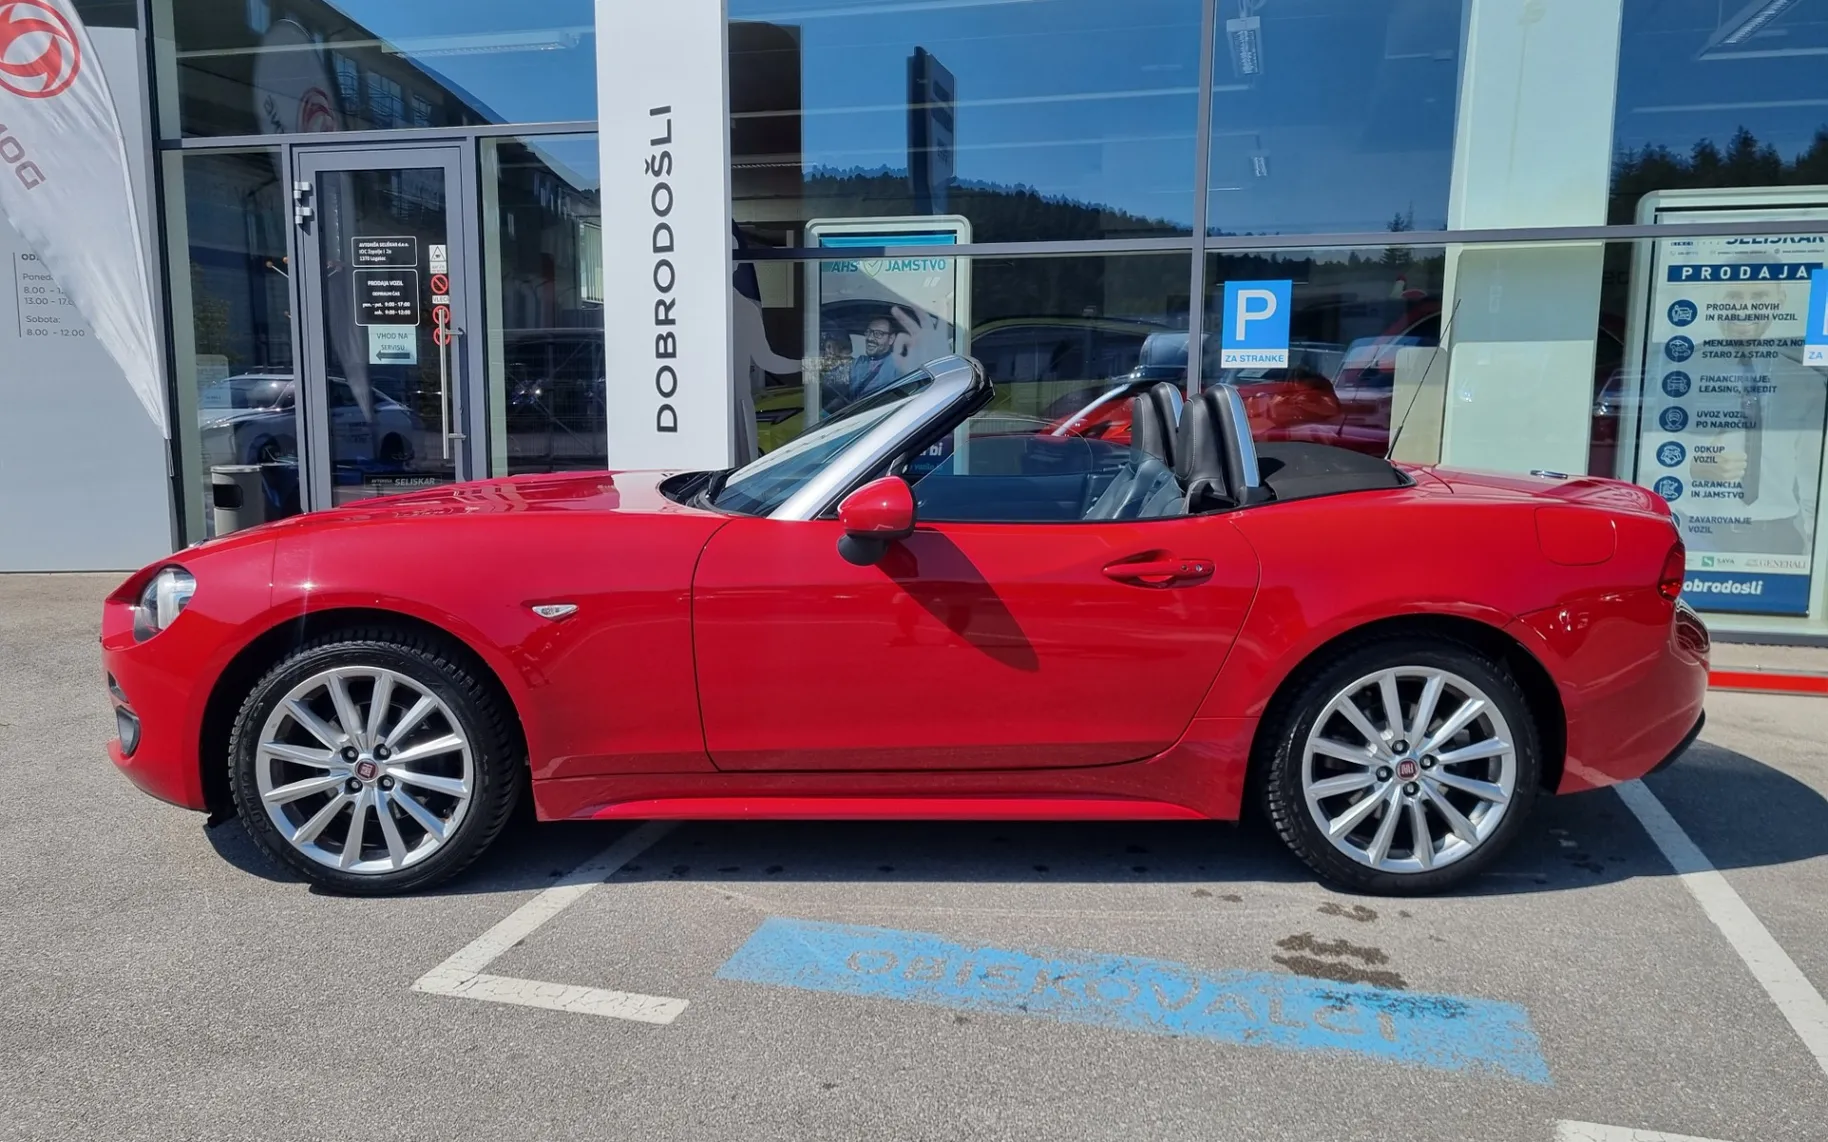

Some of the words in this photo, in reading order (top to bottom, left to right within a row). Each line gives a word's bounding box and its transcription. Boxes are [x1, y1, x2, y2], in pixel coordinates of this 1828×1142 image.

[644, 105, 678, 433] DOBRODOŠLI
[885, 259, 947, 272] JAMSTVO
[1681, 265, 1809, 280] PRODAJA
[24, 286, 46, 294] 8.00
[1706, 303, 1749, 311] PRODAJA
[1751, 302, 1780, 310] NOVIH
[26, 315, 61, 323] Sobota:
[1236, 289, 1277, 341] P
[1705, 313, 1715, 321] IN
[1717, 313, 1769, 321] RABLJENIH
[1772, 313, 1798, 321] VOZIL
[27, 328, 49, 336] 8.00
[377, 332, 397, 340] VHOD
[398, 332, 409, 340] NA
[1703, 339, 1744, 347] MENJAVA
[1746, 339, 1775, 347] STARO
[1776, 339, 1789, 347] ZA
[1225, 354, 1237, 363] ZA
[1240, 354, 1285, 363] STRANKE
[1702, 351, 1732, 359] STARO
[1734, 351, 1747, 359] ZA
[1747, 351, 1779, 359] STARO
[1808, 351, 1823, 360] ZA
[1699, 385, 1742, 395] LEASING,
[1743, 385, 1778, 394] KREDIT
[1696, 410, 1720, 419] UVOZ
[1723, 410, 1749, 419] VOZIL
[1696, 420, 1708, 429] PO
[1694, 445, 1726, 454] ODKUP
[1693, 455, 1718, 464] VOZIL
[1691, 480, 1743, 489] GARANCIJA
[1702, 491, 1745, 499] JAMSTVO
[1688, 515, 1752, 525] ZAVAROVANJE
[1688, 525, 1713, 534] VOZIL
[1759, 559, 1807, 569] GENERALI
[846, 950, 1397, 1042] OBISKOVALCI
